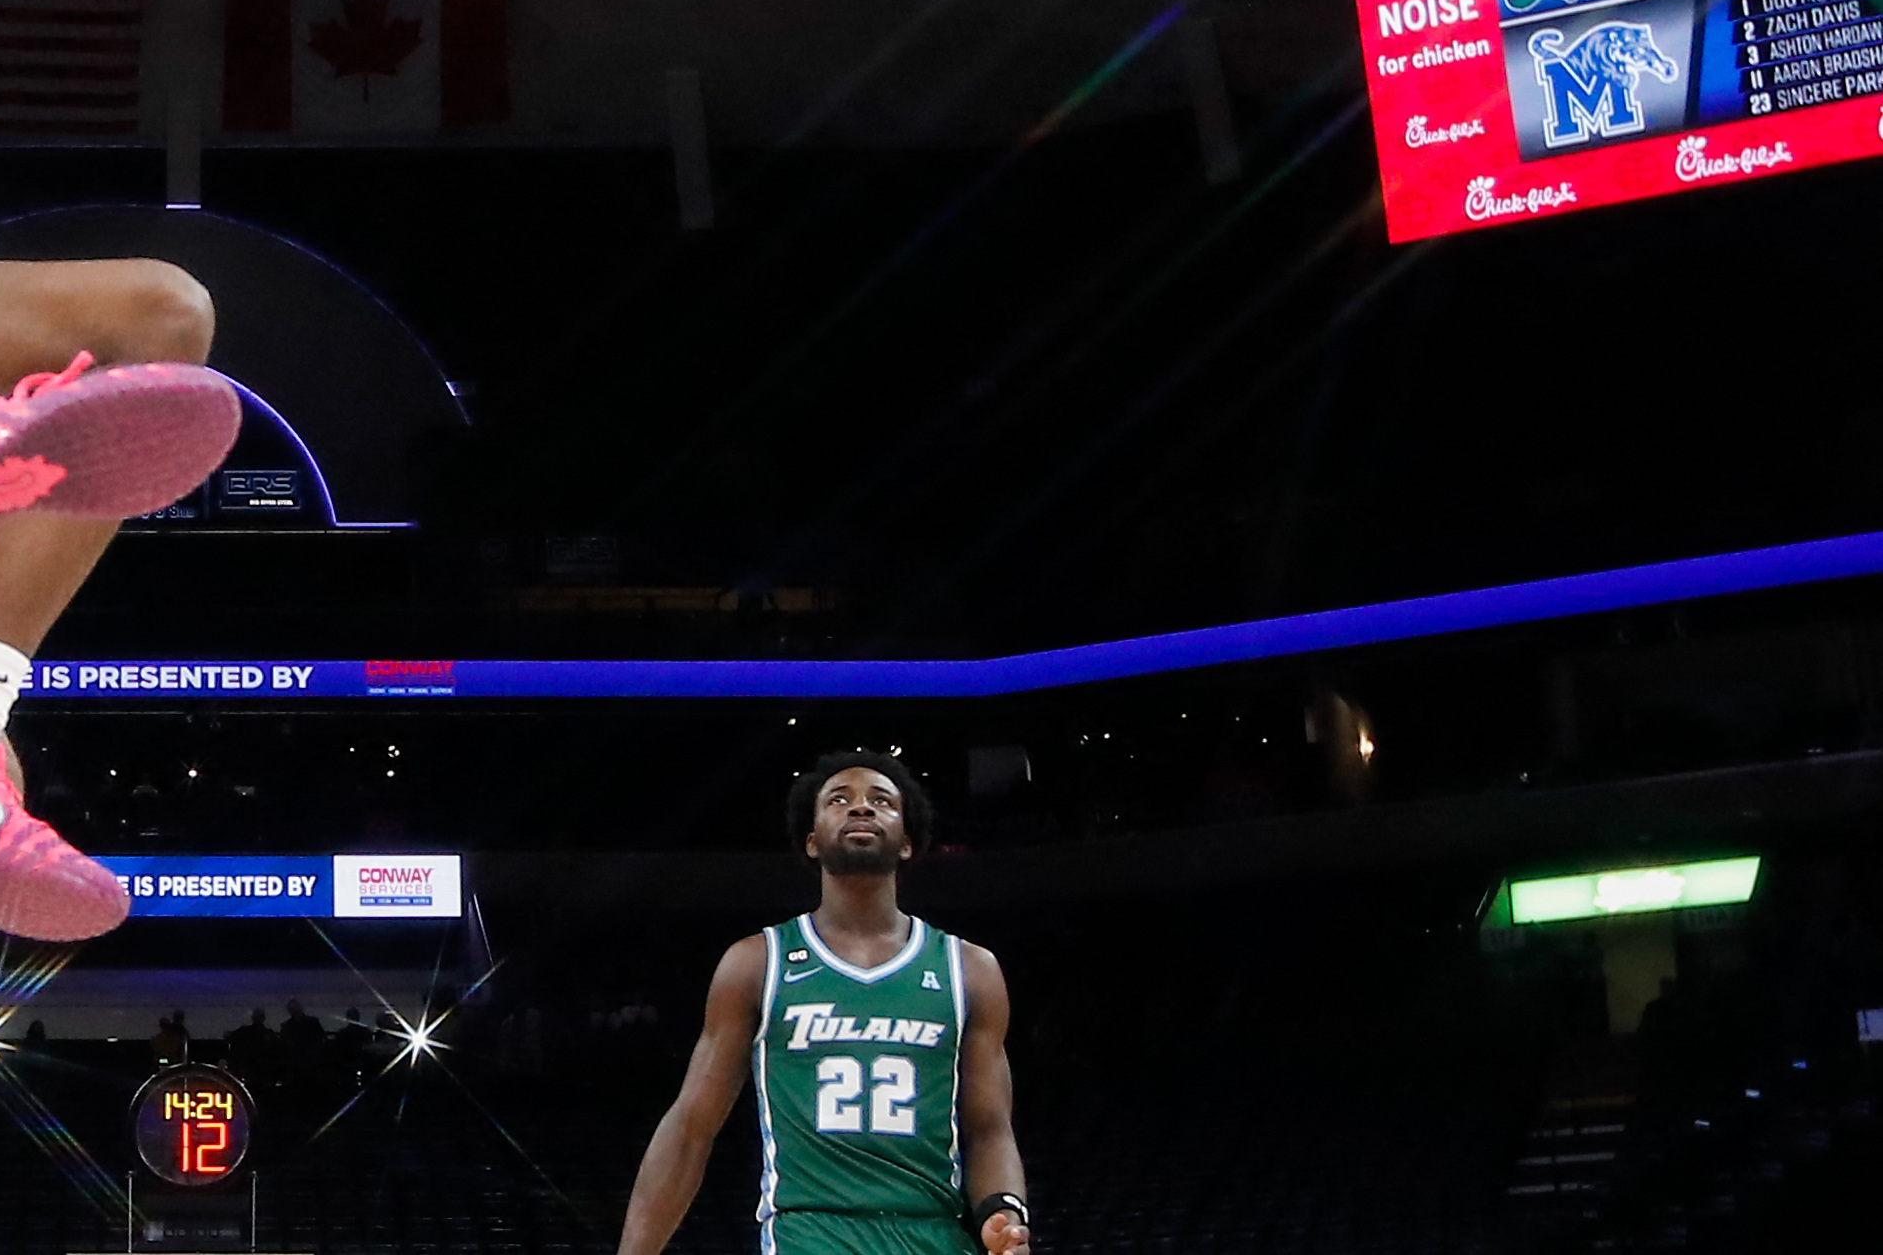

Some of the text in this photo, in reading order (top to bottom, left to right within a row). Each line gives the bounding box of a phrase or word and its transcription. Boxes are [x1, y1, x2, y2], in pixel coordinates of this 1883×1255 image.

[1743, 0, 1861, 42] 2 ZACH DAVIS
[1378, 37, 1491, 76] for chicken
[1747, 45, 1759, 65] 3
[1770, 33, 1823, 61] ASHTON
[1750, 69, 1763, 90] 11
[1774, 58, 1822, 85] AARON
[1750, 92, 1772, 115] 23
[1777, 79, 1843, 110] SINCERE
[42, 665, 71, 689] IS
[79, 665, 265, 689] PRESENTED
[272, 665, 315, 689] BY
[134, 875, 154, 897] IS
[158, 875, 284, 897] PRESENTED
[288, 875, 317, 897] BY
[359, 867, 434, 884] CONWAY
[359, 884, 433, 895] SERVICES
[783, 1001, 946, 1051] TULANE
[163, 1091, 234, 1120] 14:24
[816, 1054, 917, 1137] 22
[181, 1121, 228, 1173] 12
